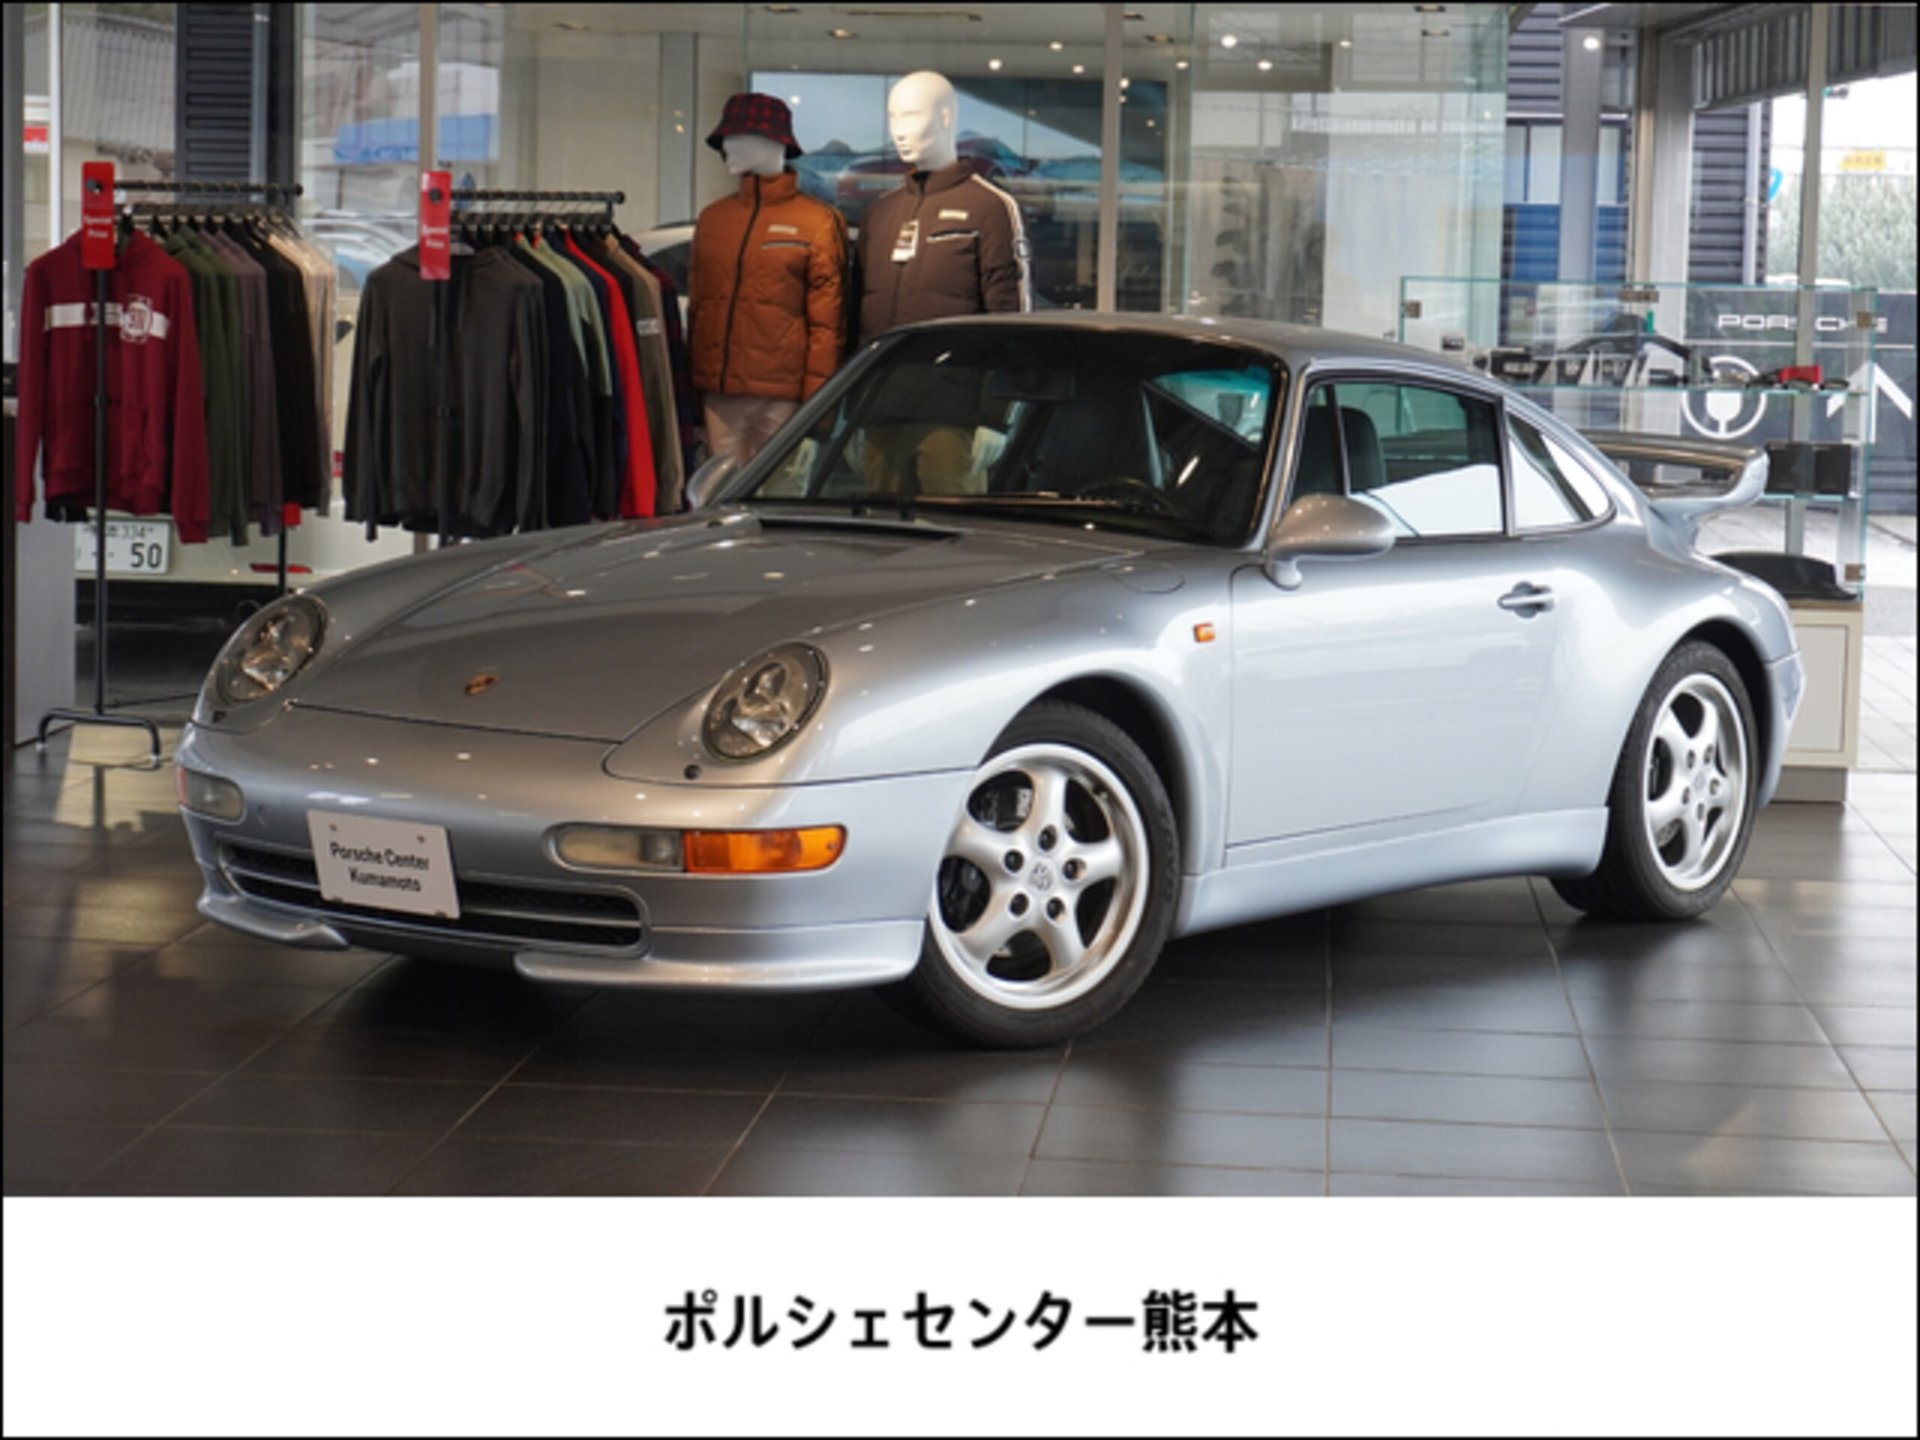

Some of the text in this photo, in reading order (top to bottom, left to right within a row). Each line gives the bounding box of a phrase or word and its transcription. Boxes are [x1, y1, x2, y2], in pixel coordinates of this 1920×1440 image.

[130, 541, 163, 570] 50
[329, 841, 430, 871] Porsche Center
[348, 866, 422, 893] Kumamoto
